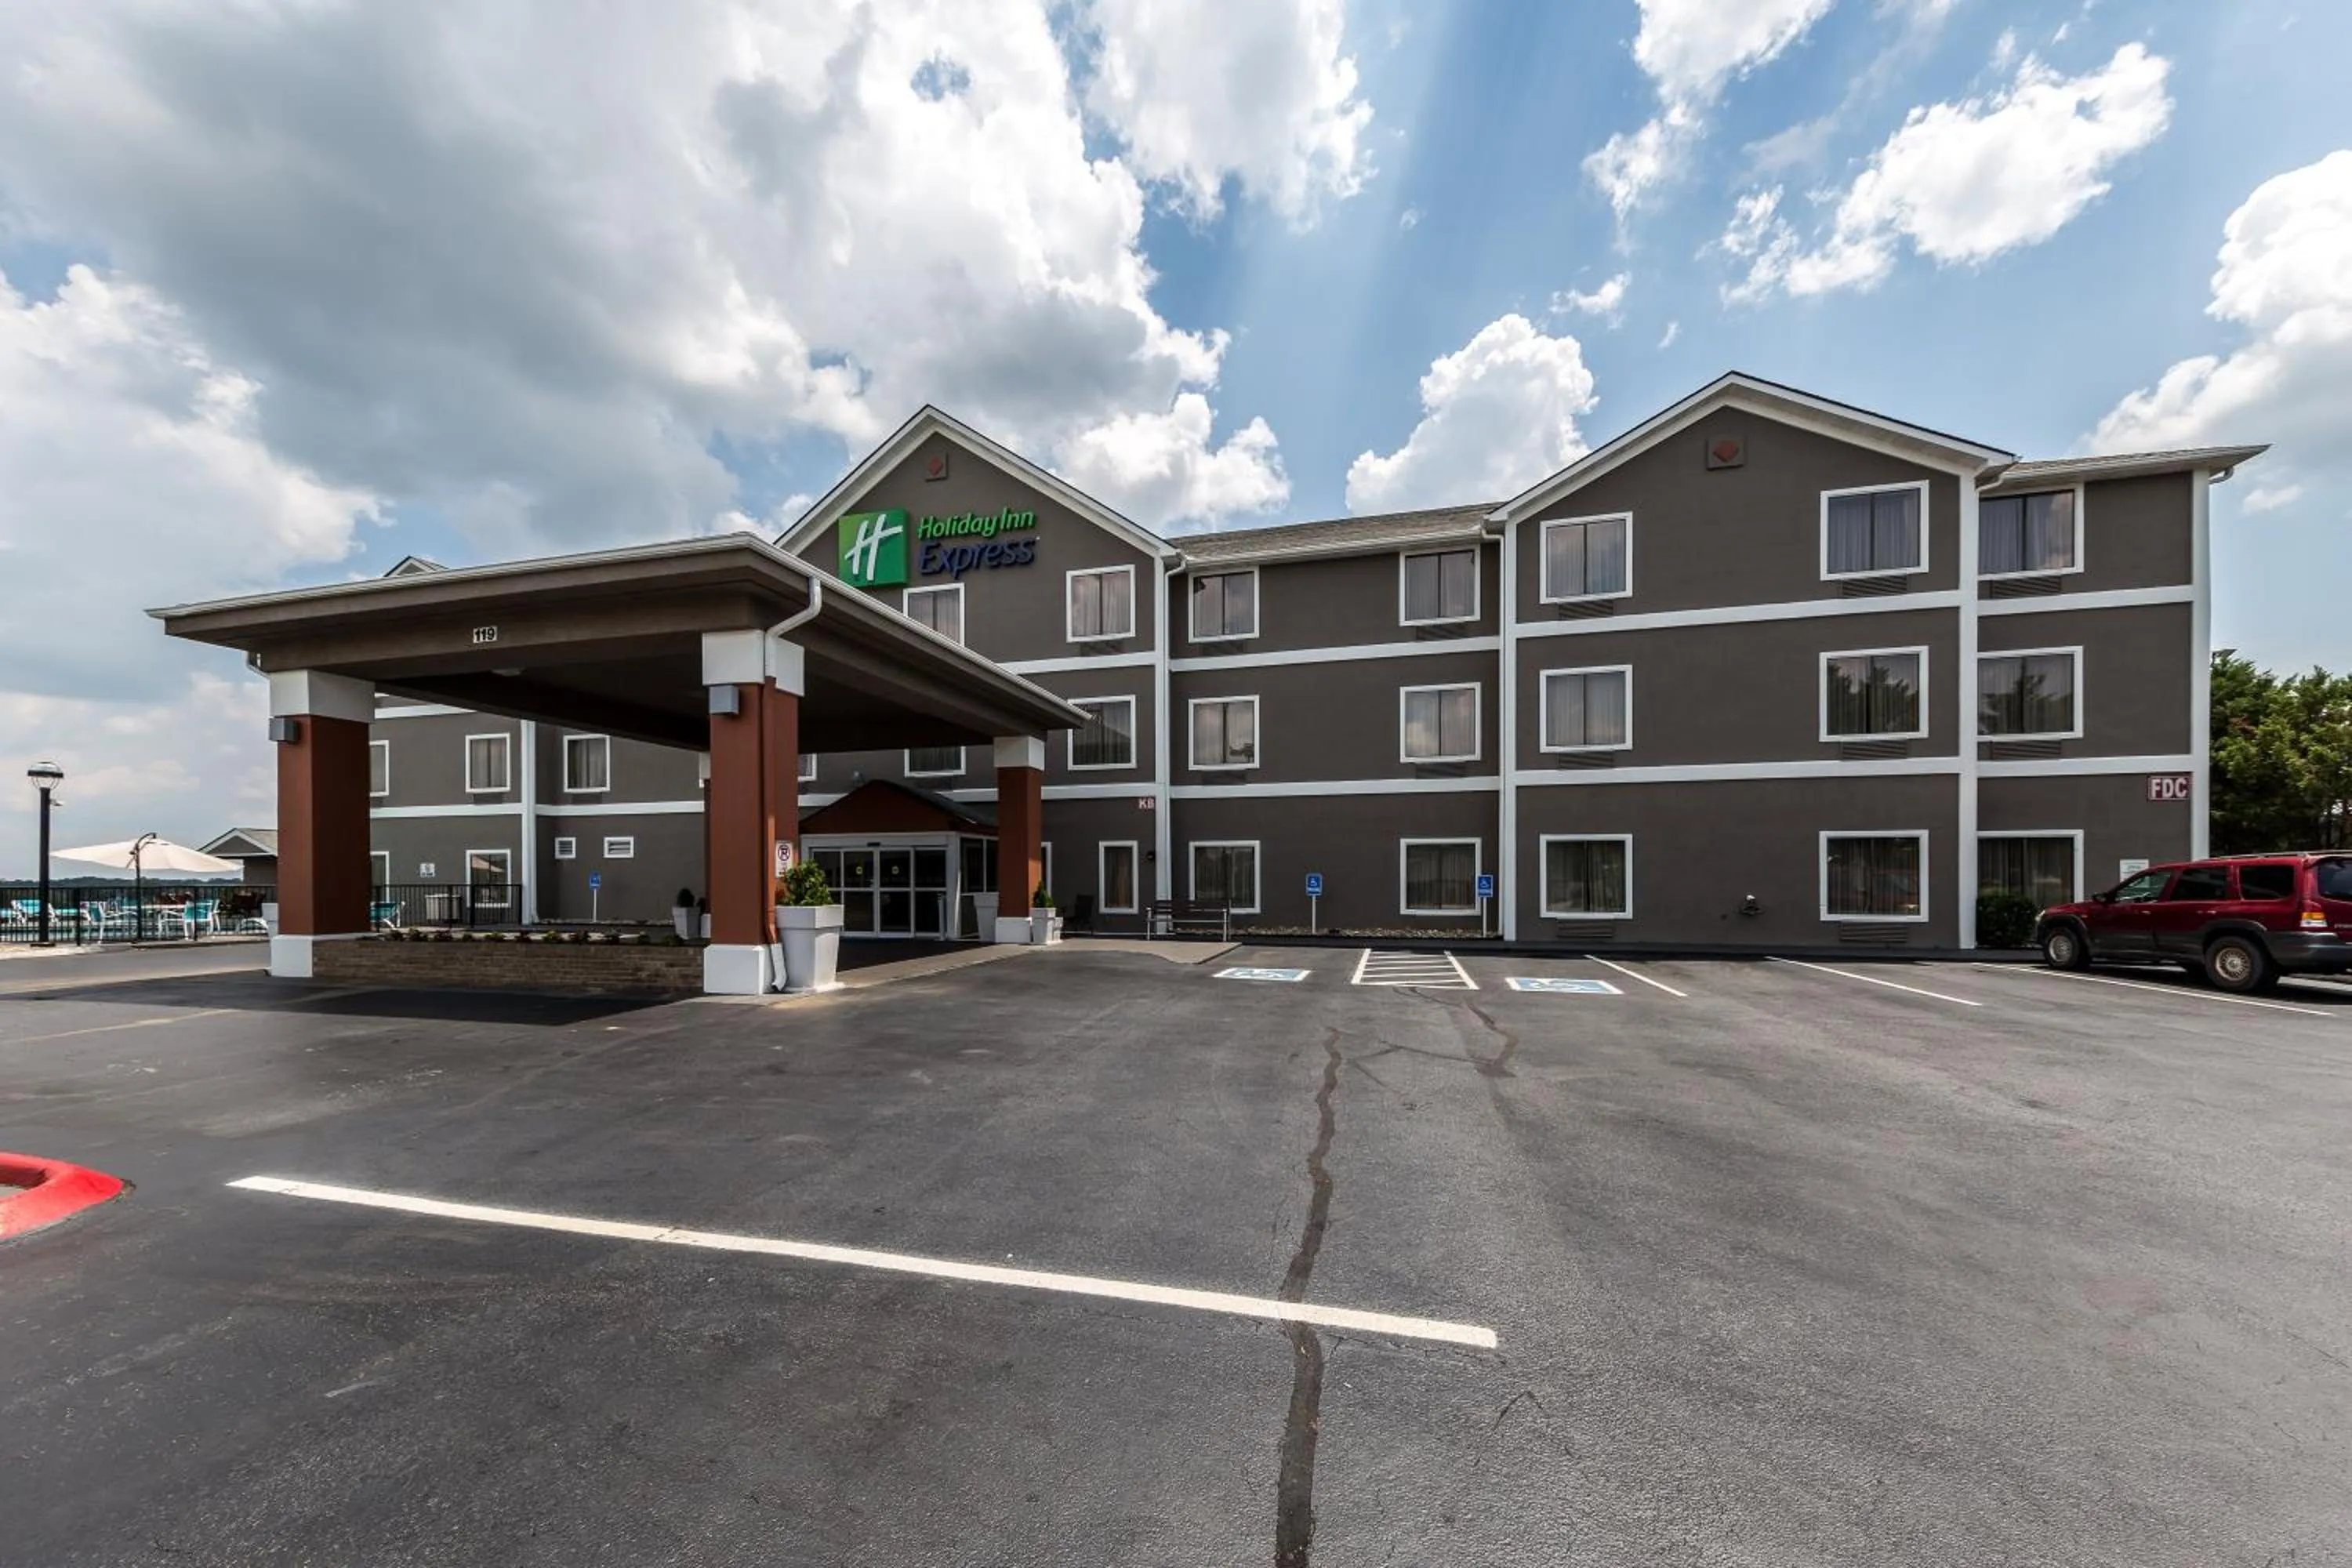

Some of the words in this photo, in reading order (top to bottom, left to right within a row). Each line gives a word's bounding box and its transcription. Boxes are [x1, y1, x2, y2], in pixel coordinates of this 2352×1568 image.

[917, 512, 997, 539] Holiday
[1000, 506, 1036, 531] Inn
[919, 538, 1036, 580] Express
[474, 628, 495, 641] 119
[2151, 778, 2187, 797] FDC
